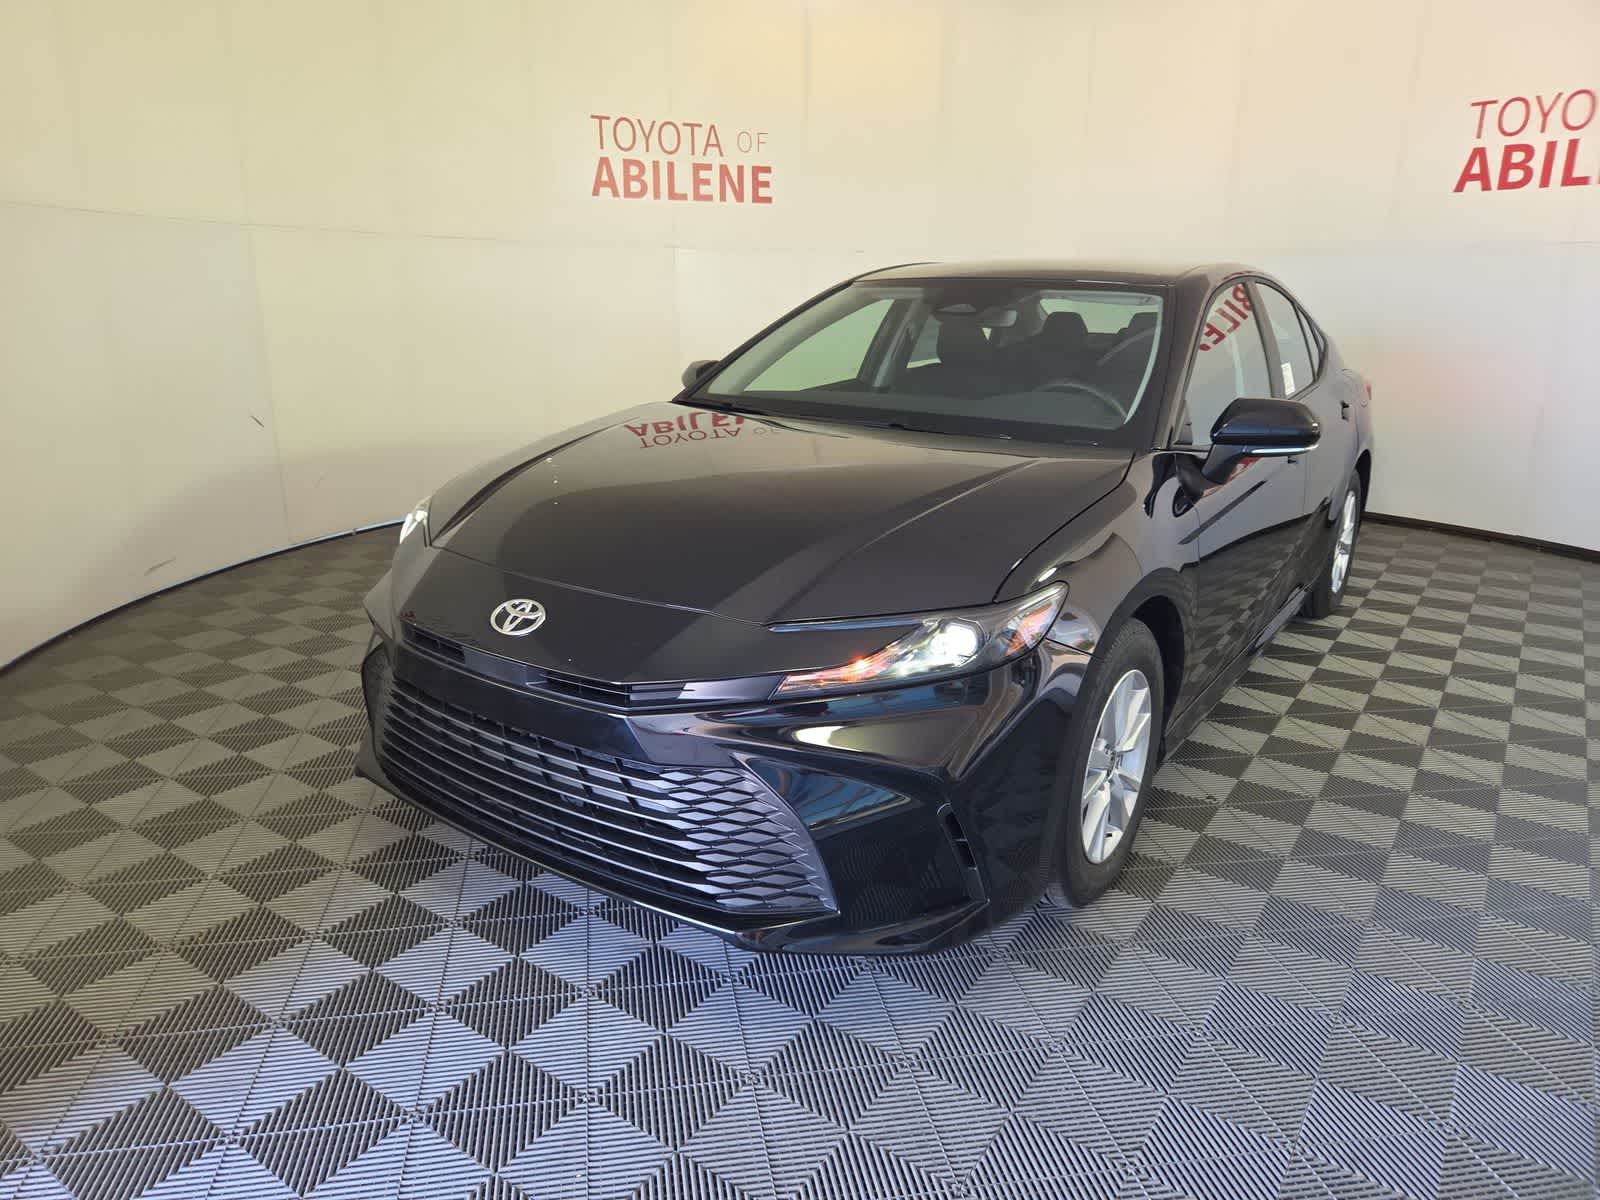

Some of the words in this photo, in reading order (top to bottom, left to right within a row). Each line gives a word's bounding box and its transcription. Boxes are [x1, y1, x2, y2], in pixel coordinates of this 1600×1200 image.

[590, 114, 724, 157] TOYOTA
[736, 131, 768, 153] OF
[592, 156, 773, 204] ABILENE
[1453, 138, 1600, 193] ABIL
